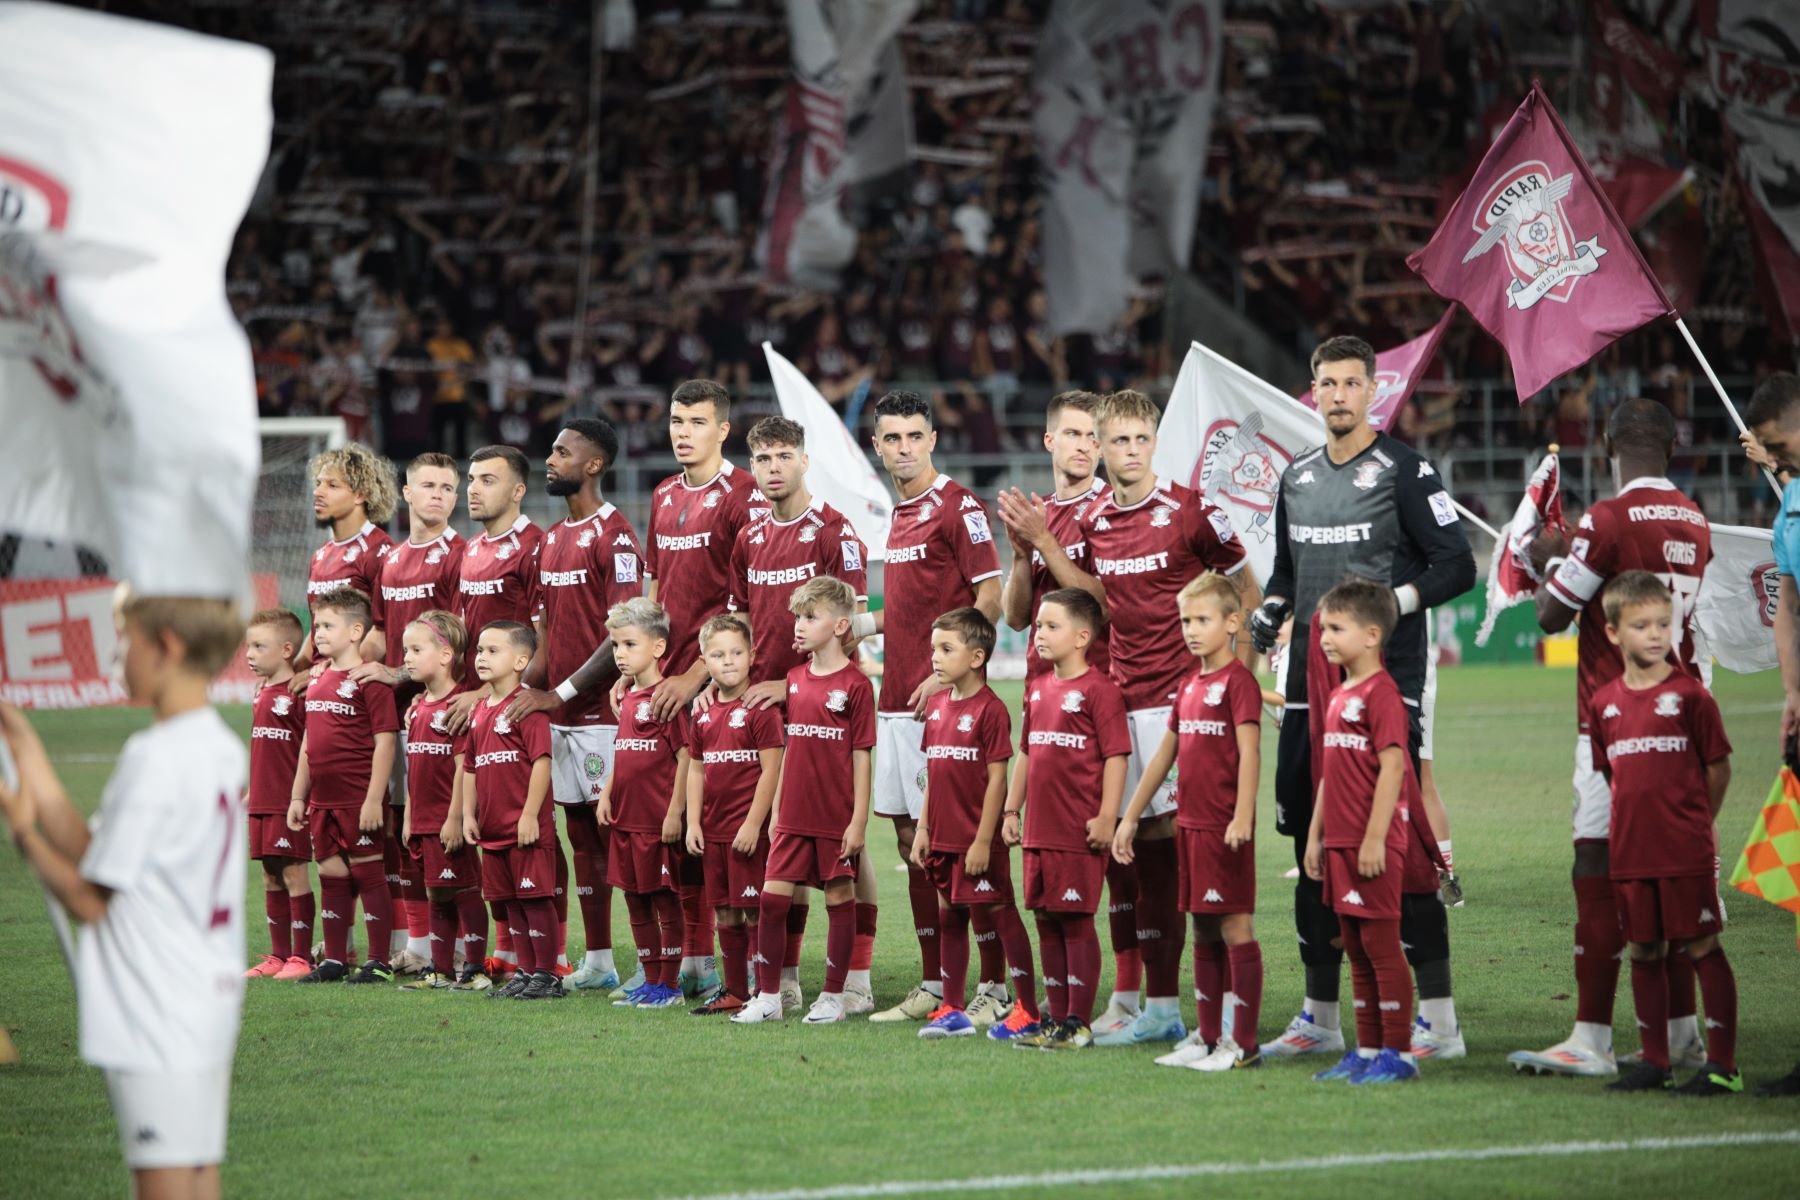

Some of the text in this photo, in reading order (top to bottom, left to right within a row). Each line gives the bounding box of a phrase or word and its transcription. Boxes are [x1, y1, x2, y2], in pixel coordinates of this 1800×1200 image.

[656, 532, 711, 551] UPERBET
[971, 531, 986, 543] DS
[1663, 540, 1697, 565] CHRIS
[747, 562, 817, 586] SUPERBET
[844, 559, 861, 570] DS
[616, 572, 632, 582] DS
[381, 583, 436, 602] UPERBET
